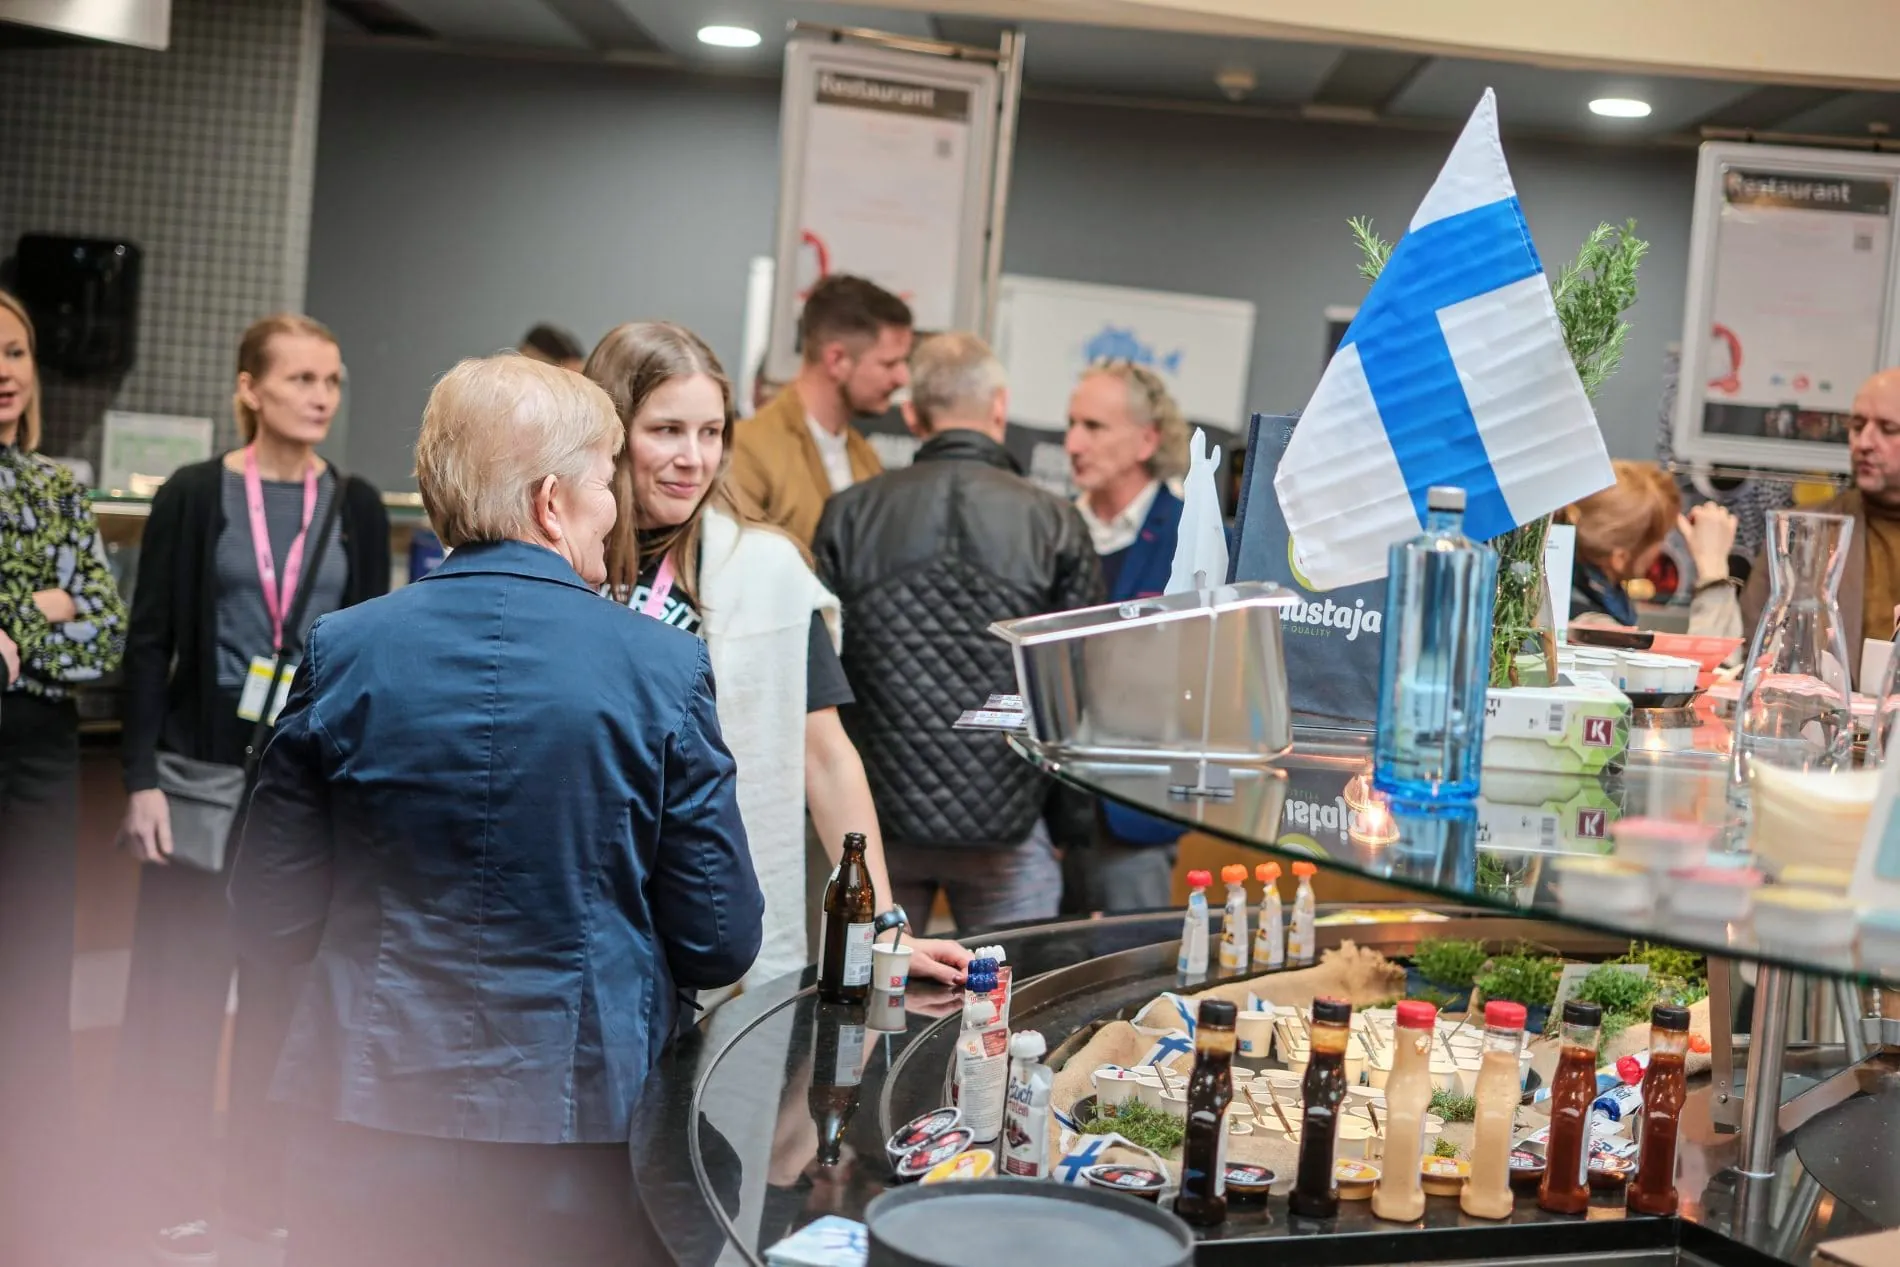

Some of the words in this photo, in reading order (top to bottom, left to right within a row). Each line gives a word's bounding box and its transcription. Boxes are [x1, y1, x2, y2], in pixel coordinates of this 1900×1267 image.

[820, 74, 936, 109] Restaurant
[1727, 171, 1850, 203] Restaurant
[1291, 625, 1331, 638] QUALITY
